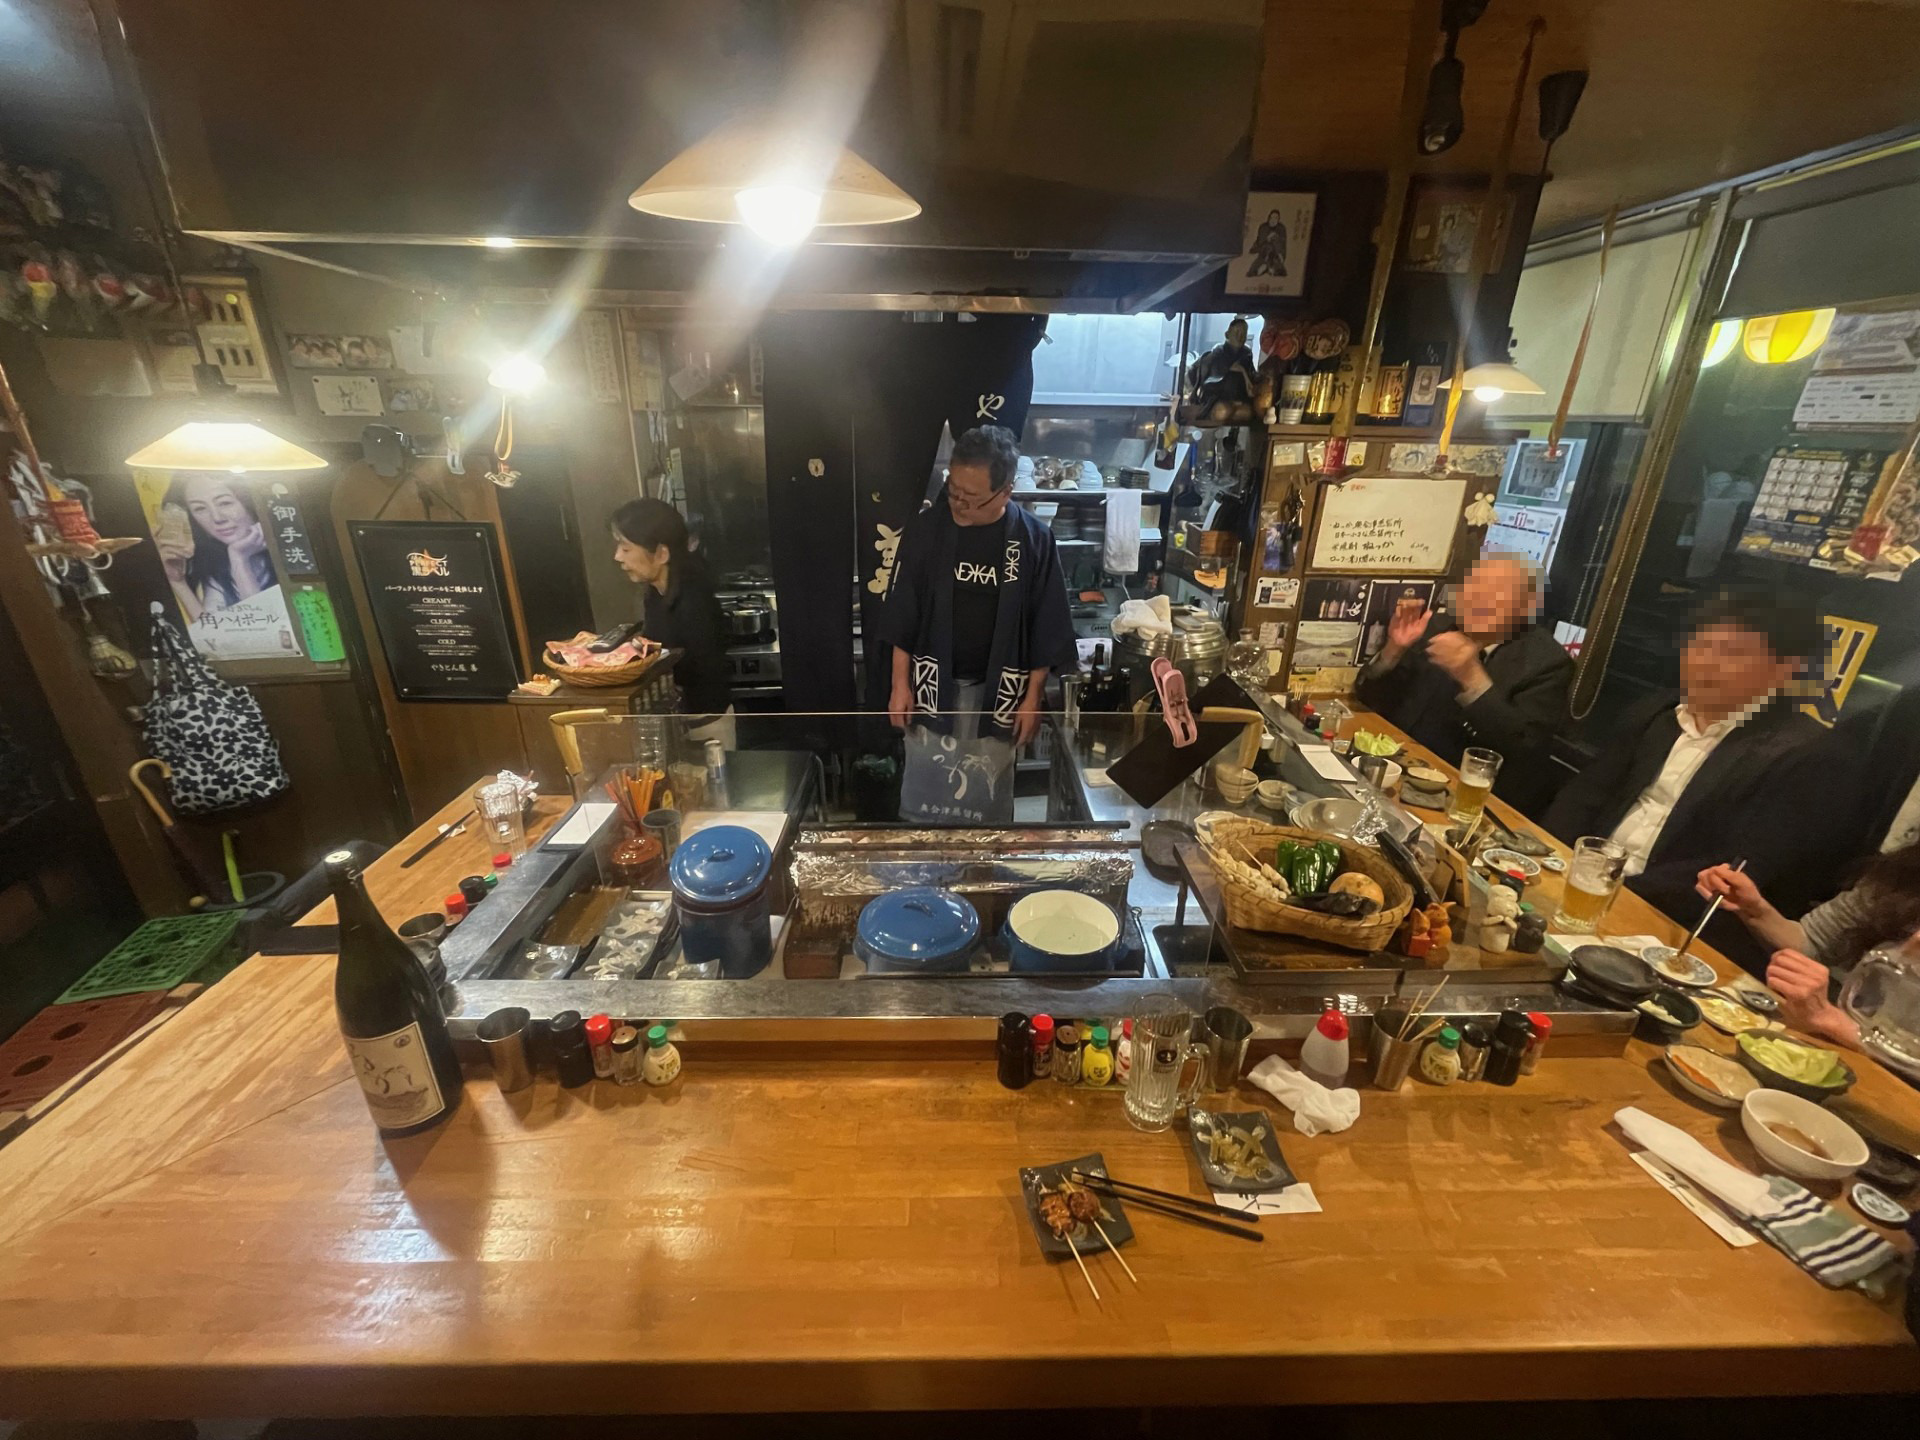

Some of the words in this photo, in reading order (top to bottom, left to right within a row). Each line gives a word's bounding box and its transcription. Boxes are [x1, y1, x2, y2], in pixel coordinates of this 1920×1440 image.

[976, 393, 1005, 421] や
[272, 504, 311, 565] 御手洗
[199, 611, 280, 630] 角ハイボール
